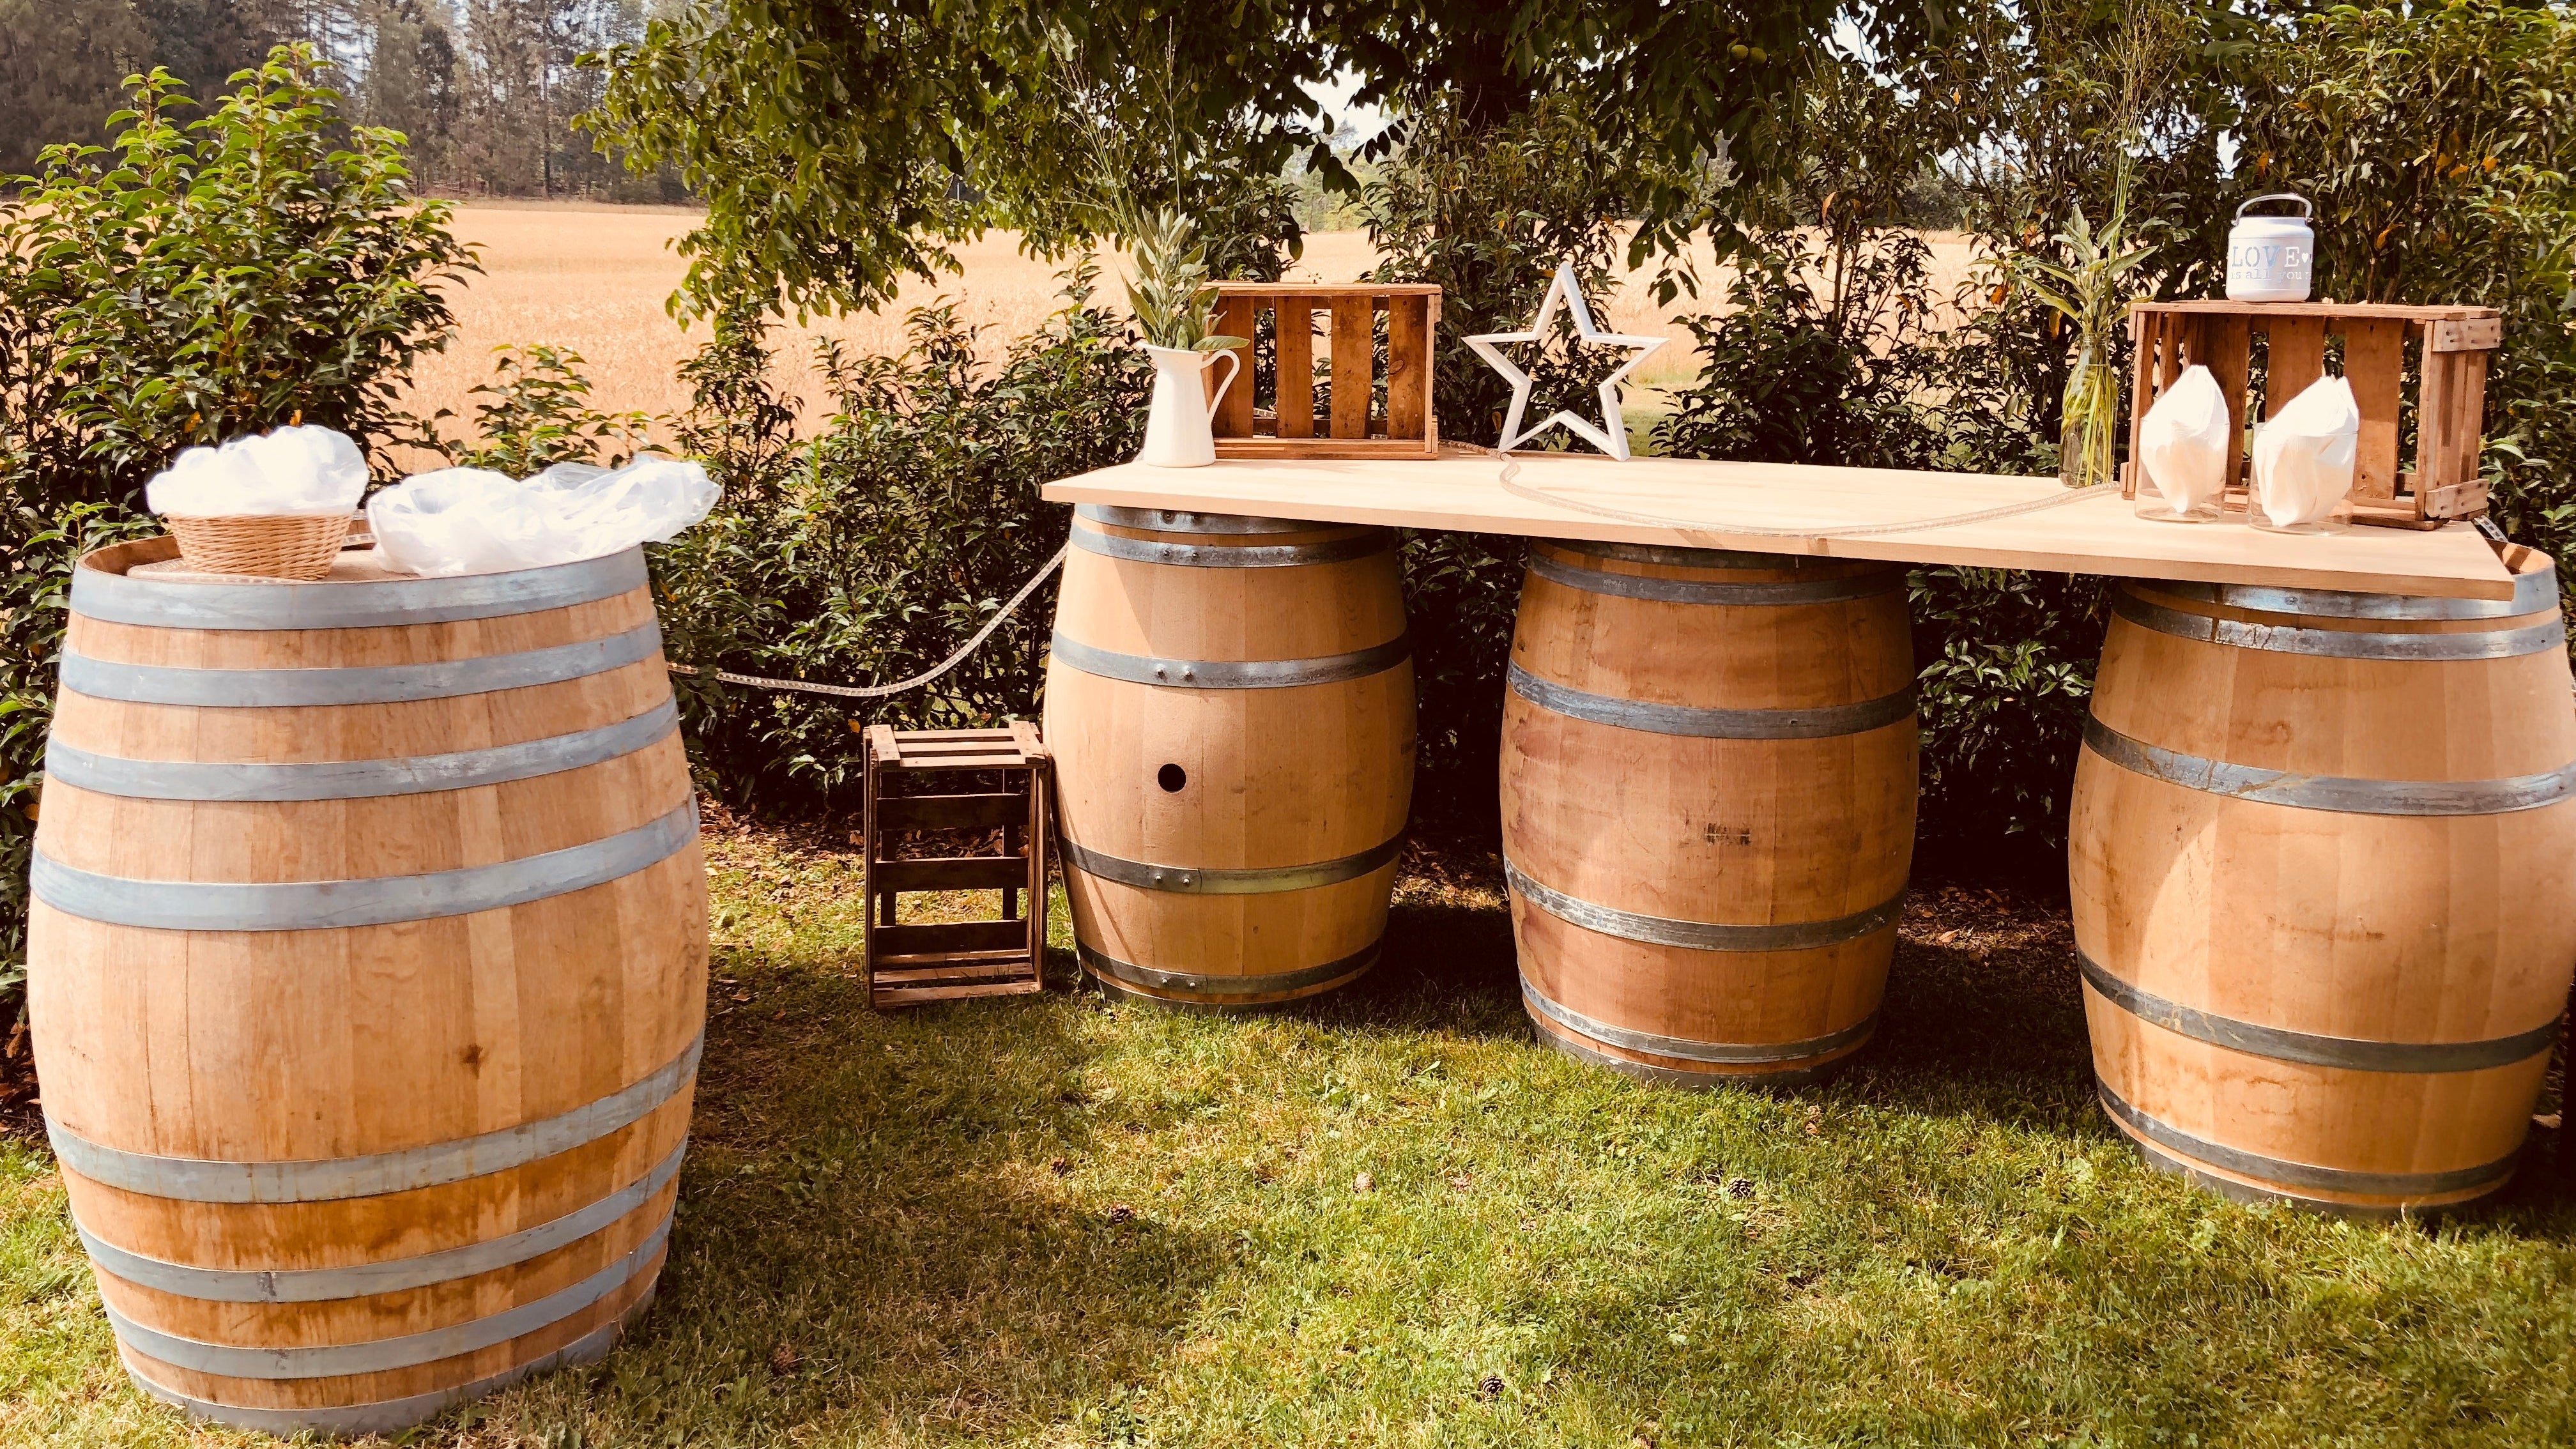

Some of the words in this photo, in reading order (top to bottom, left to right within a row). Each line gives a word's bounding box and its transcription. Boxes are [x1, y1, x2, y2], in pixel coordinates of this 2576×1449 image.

[2232, 245, 2300, 268] LOVE
[2245, 268, 2272, 280] all
[2276, 271, 2303, 283] you
